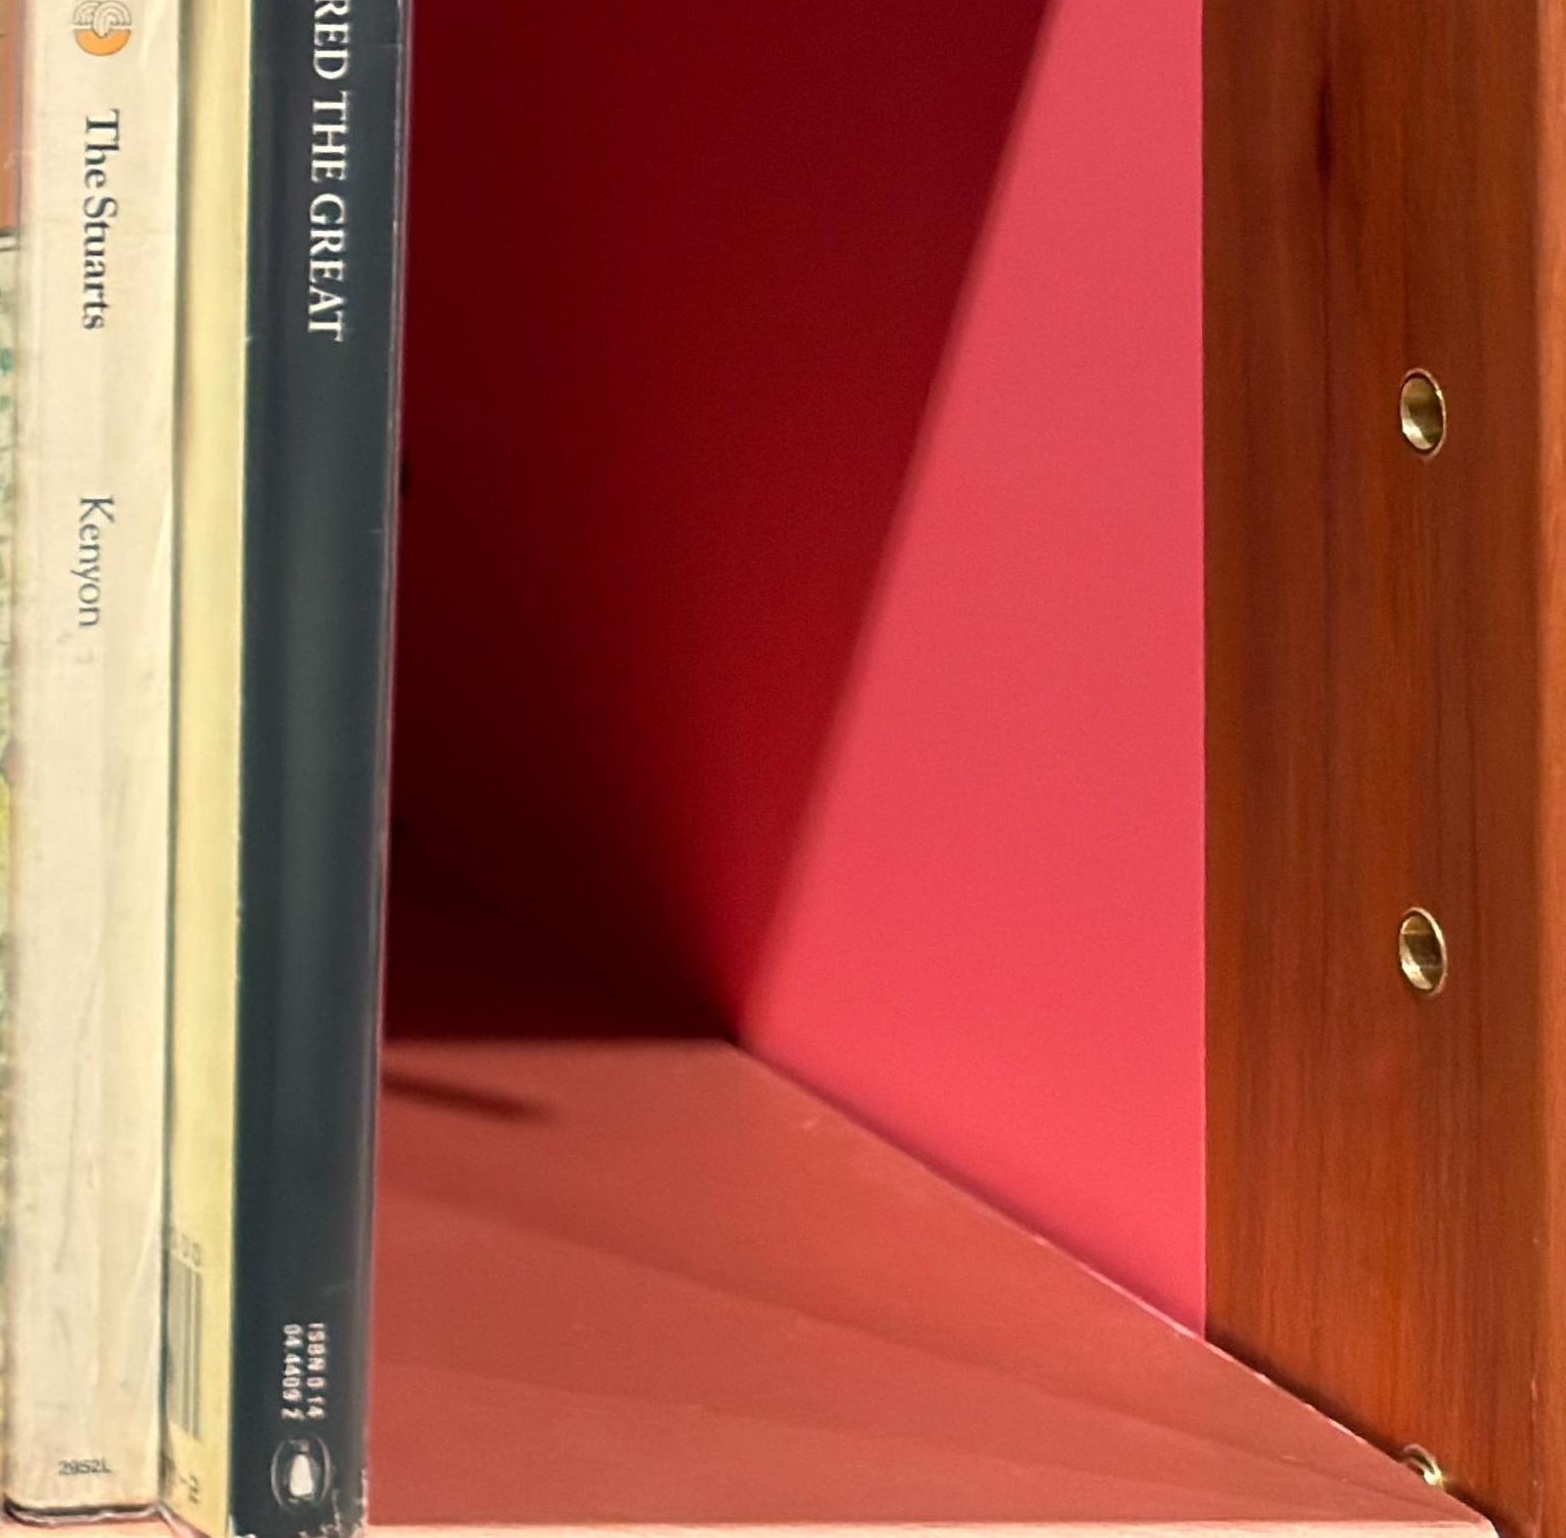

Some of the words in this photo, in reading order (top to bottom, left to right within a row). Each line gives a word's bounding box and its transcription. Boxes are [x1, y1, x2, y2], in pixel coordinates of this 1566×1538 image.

[85, 108, 120, 189] The
[311, 94, 352, 183] THE
[83, 195, 119, 331] Stuarts
[307, 193, 348, 343] GREAT
[78, 495, 116, 628] Kenyon
[307, 1322, 326, 1371] ISBN
